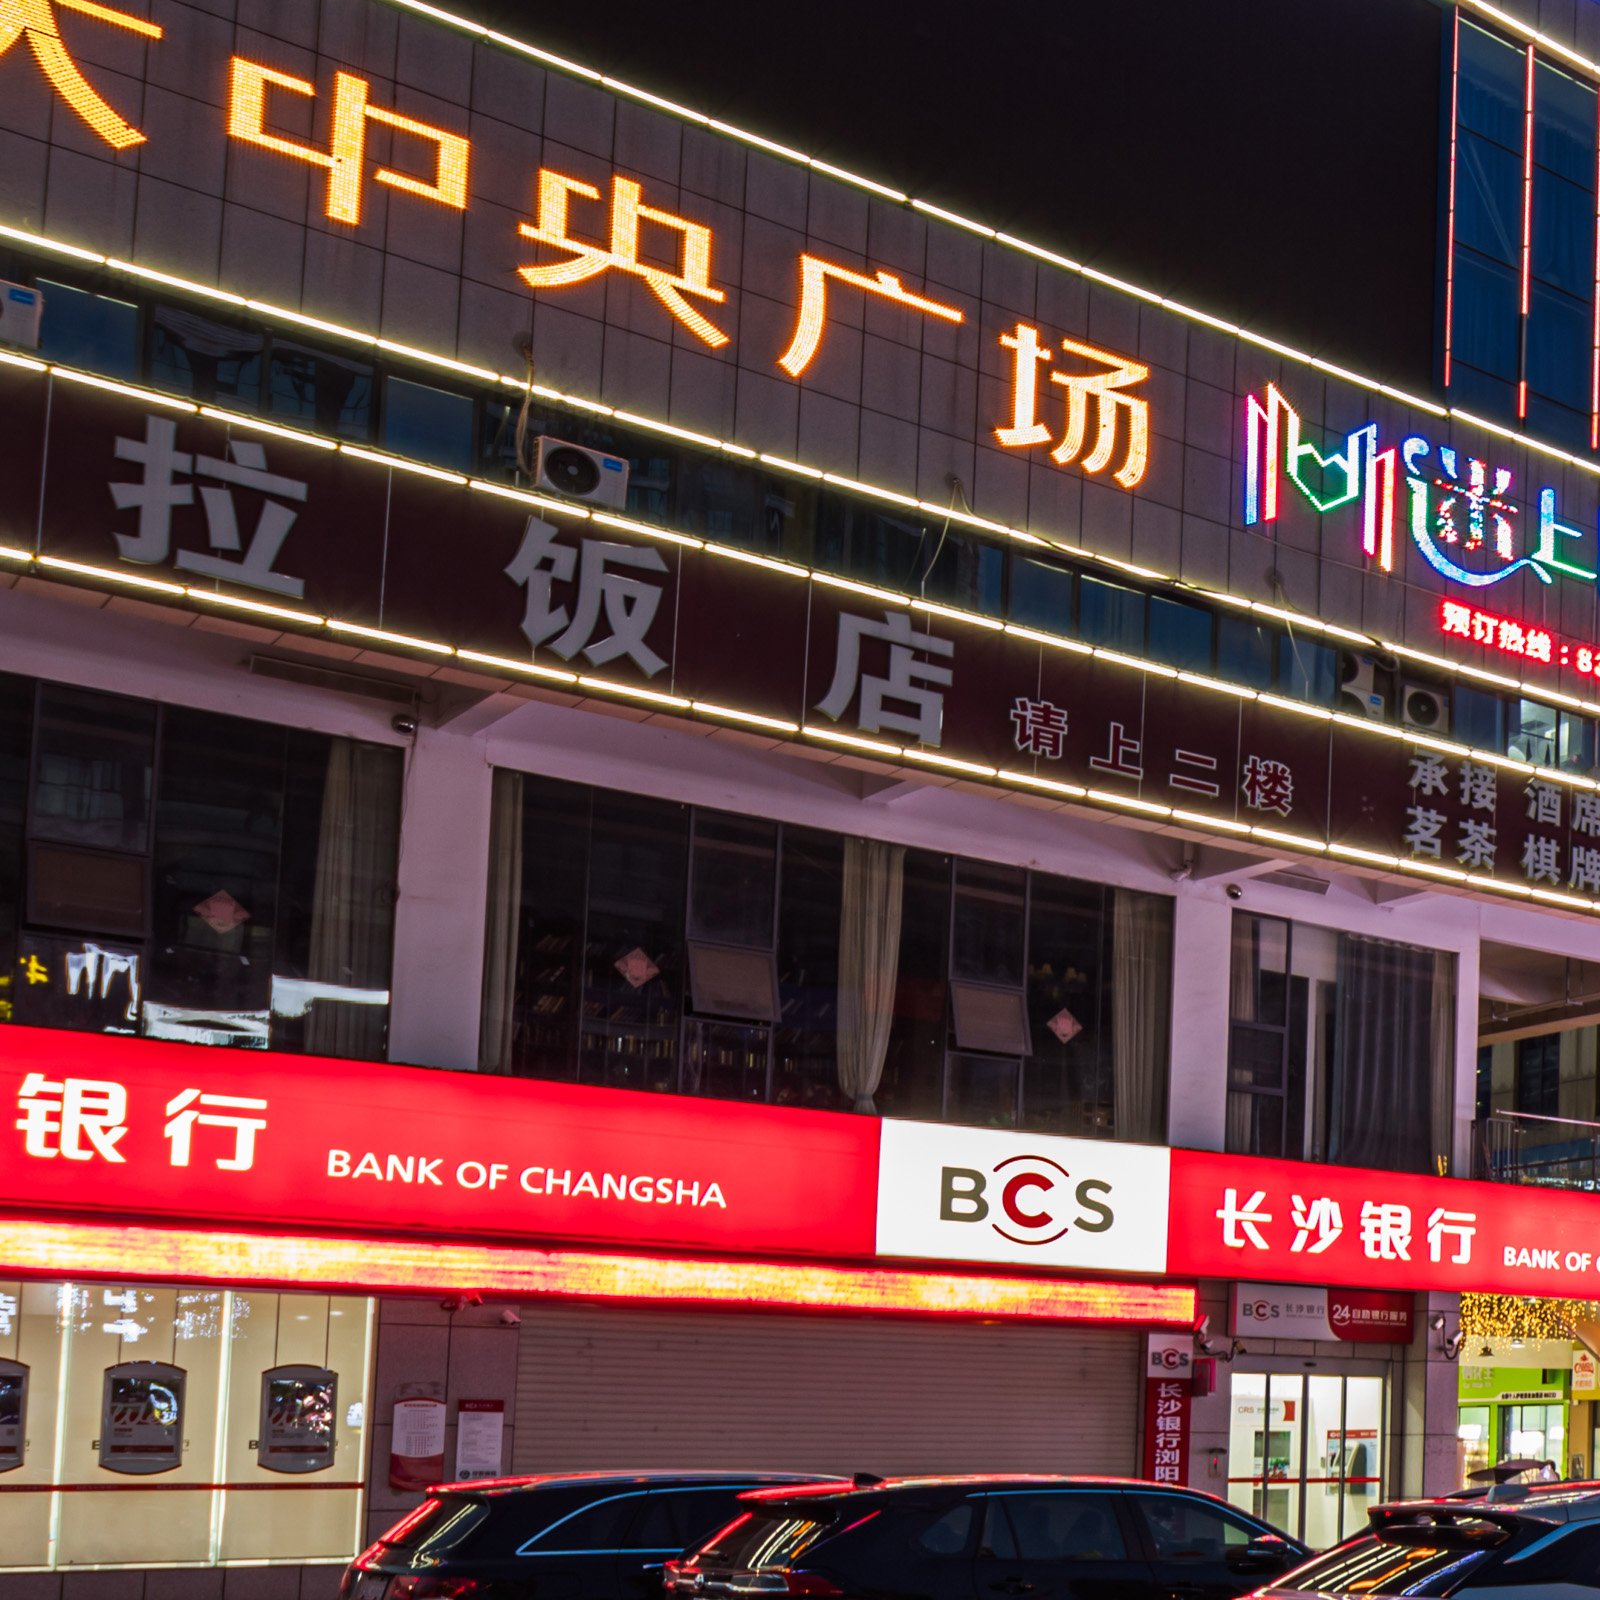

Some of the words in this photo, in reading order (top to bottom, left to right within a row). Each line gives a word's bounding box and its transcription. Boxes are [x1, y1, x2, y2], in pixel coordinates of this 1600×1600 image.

[109, 414, 955, 748] 拉饭店
[1010, 697, 1294, 817] 请上二楼
[1408, 748, 1498, 813] 承接
[1403, 804, 1498, 871] 茗茶
[15, 1070, 269, 1172] 银行
[326, 1148, 444, 1188] BANK
[455, 1160, 509, 1193] OF
[518, 1165, 728, 1211] CHANGSHA
[938, 1160, 1115, 1240] BCS
[1216, 1186, 1478, 1267] 长沙银行
[1502, 1245, 1560, 1270] BANK
[1565, 1251, 1592, 1273] OF
[1242, 1302, 1281, 1320] BCS
[1285, 1302, 1325, 1315] 长沙银行
[1332, 1303, 1351, 1320] 24
[1151, 1351, 1189, 1368] BCS
